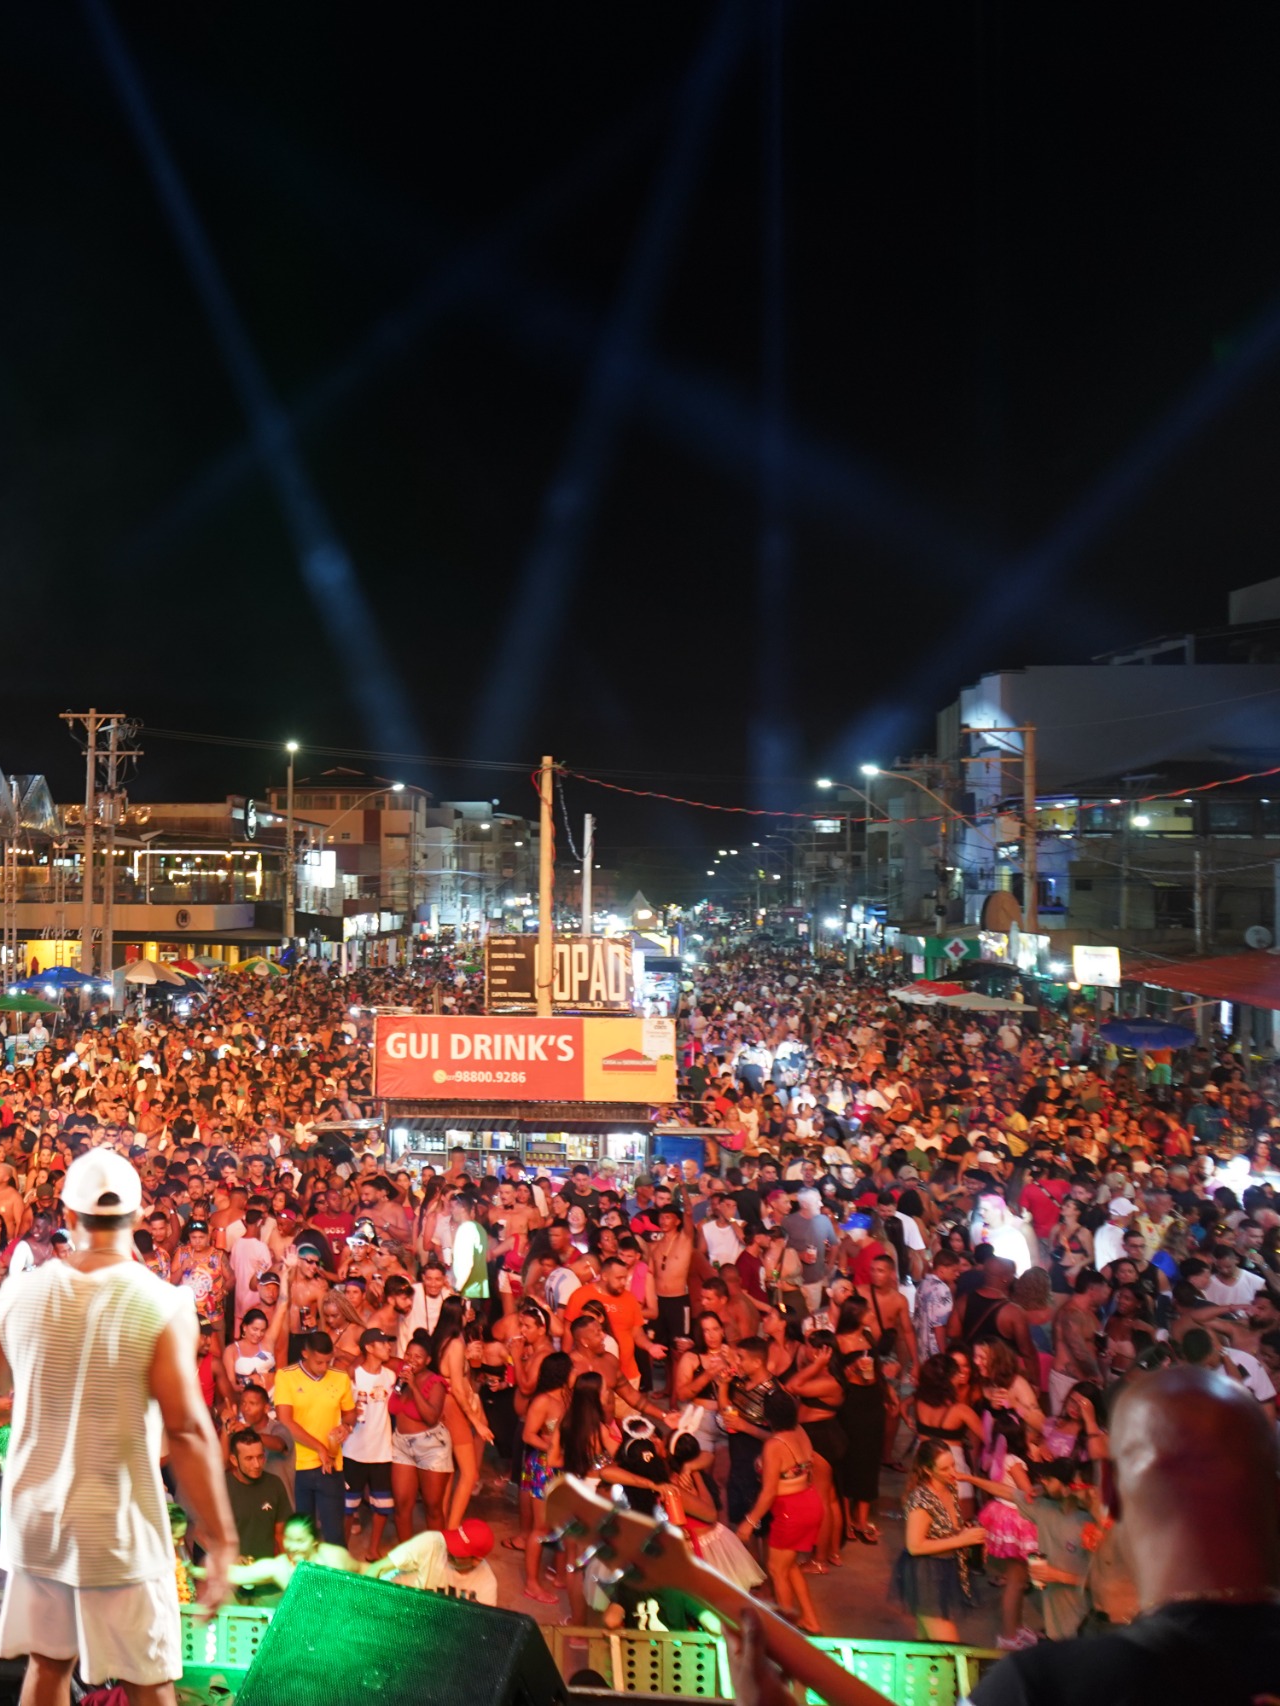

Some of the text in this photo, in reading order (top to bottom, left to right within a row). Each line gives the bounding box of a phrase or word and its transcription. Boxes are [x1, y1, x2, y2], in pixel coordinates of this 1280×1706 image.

[535, 939, 625, 1000] OPÃO
[386, 1032, 575, 1062] GUI DRINK'S
